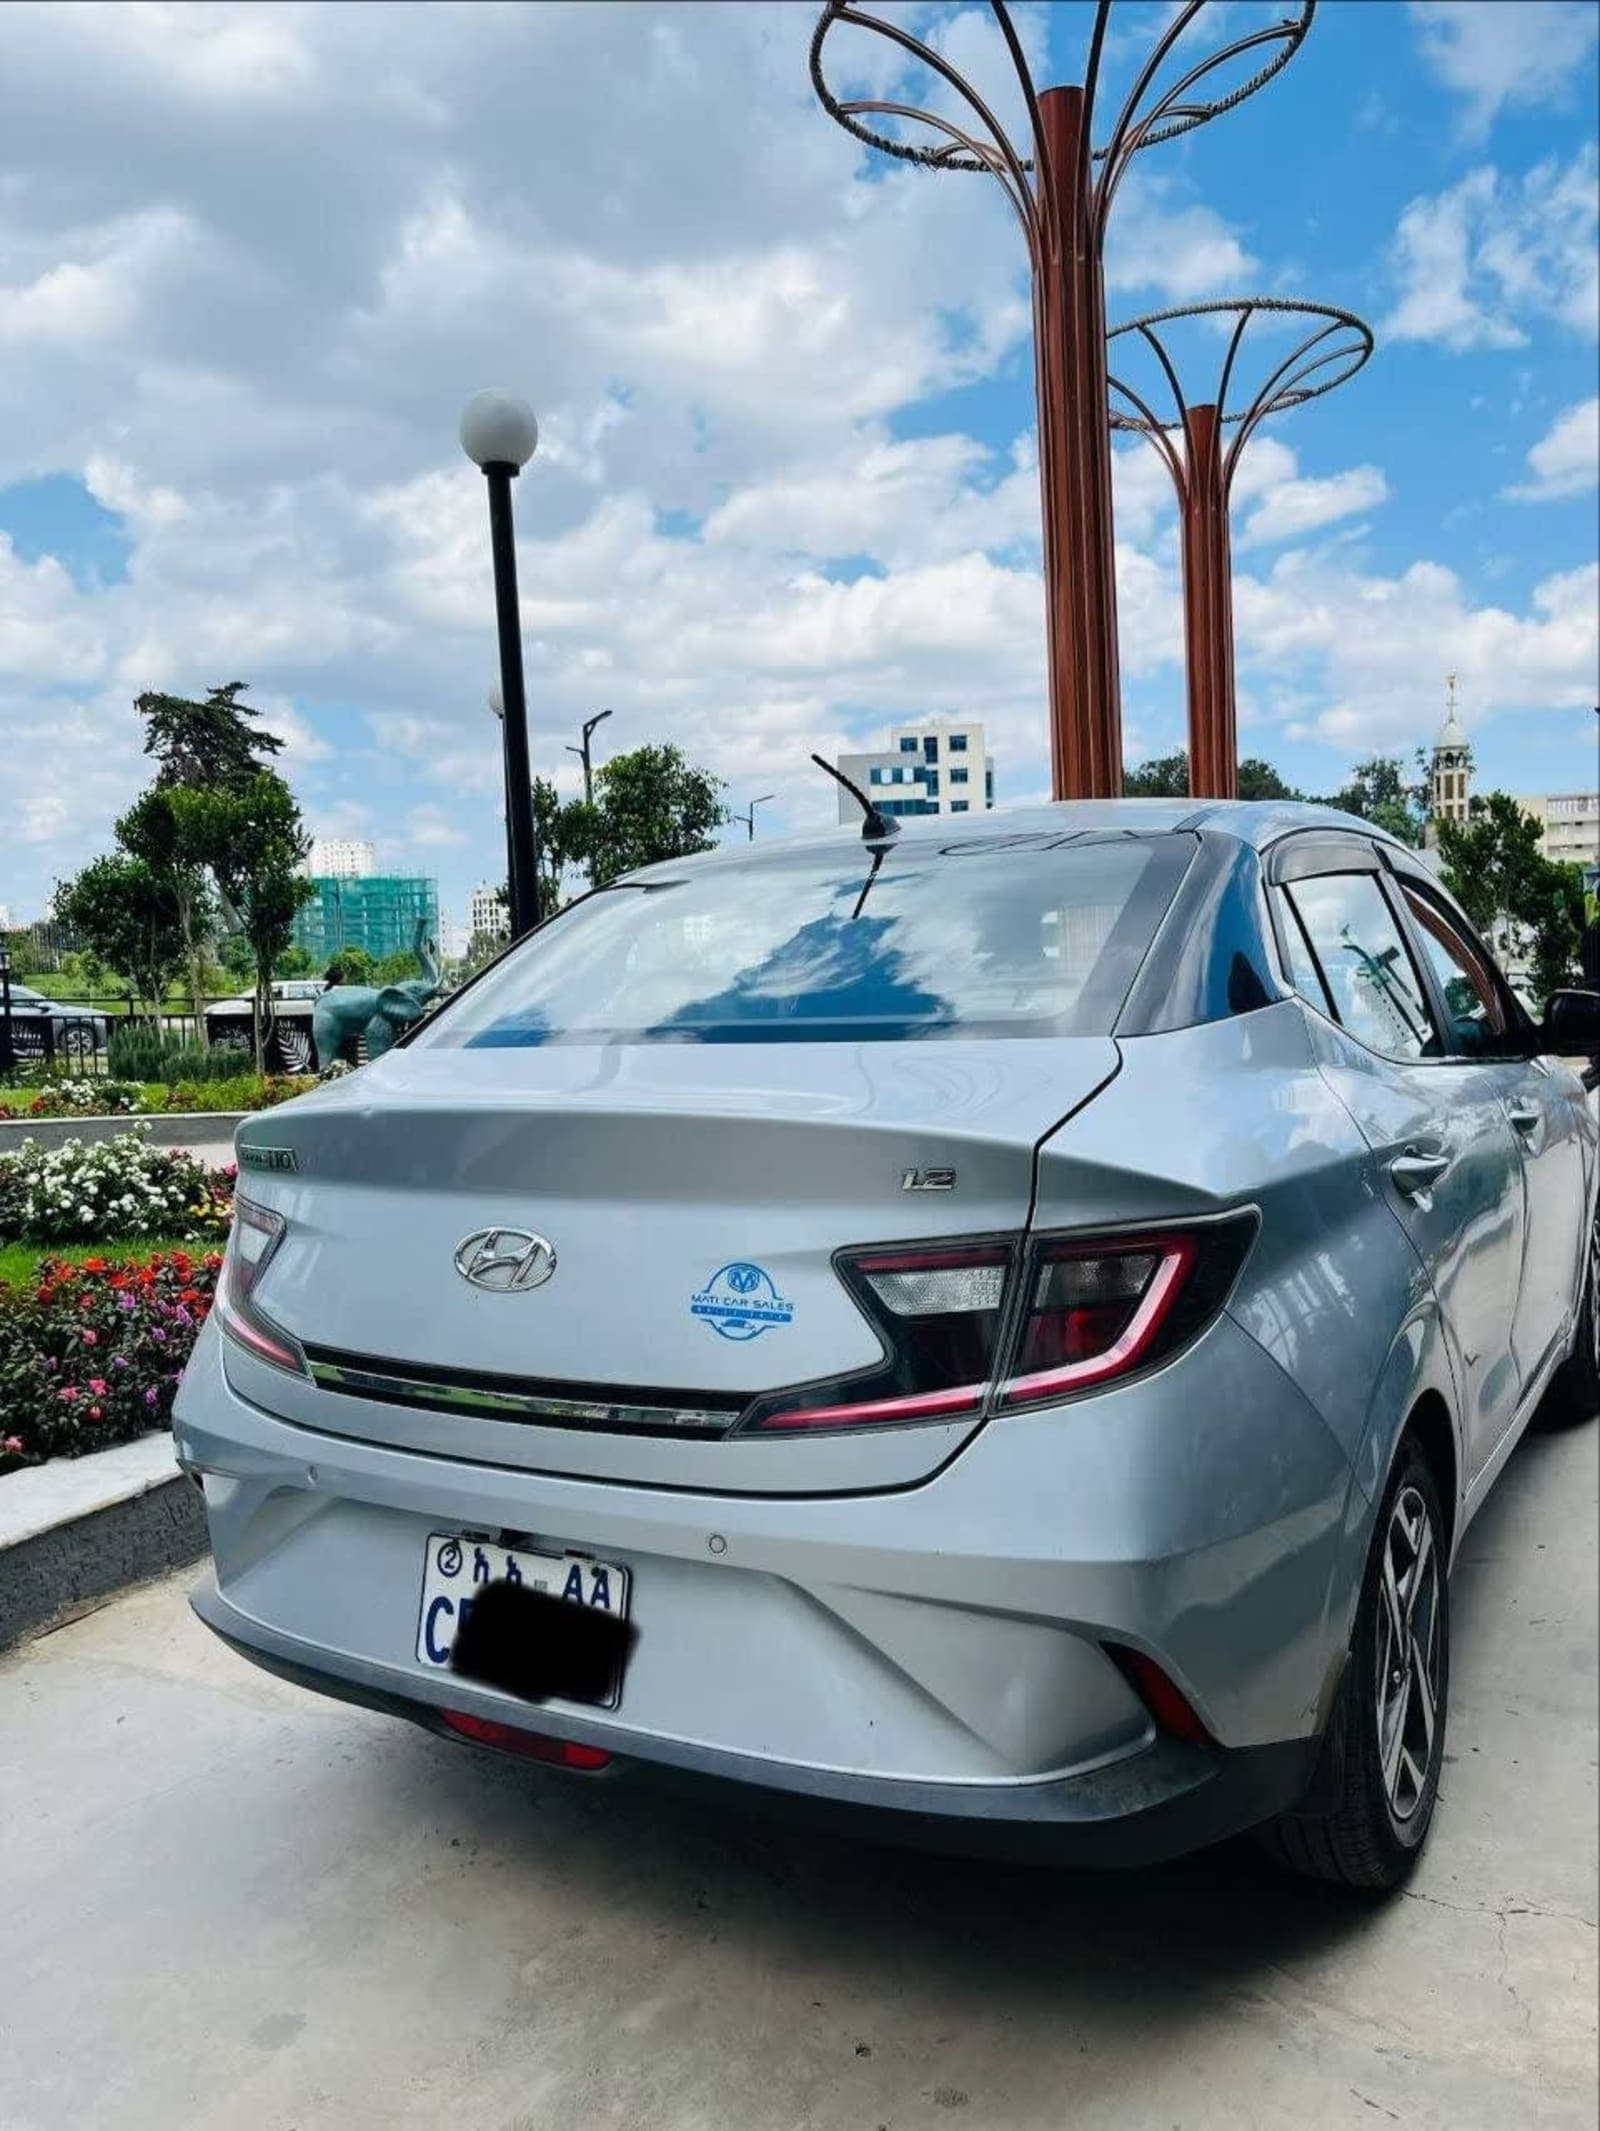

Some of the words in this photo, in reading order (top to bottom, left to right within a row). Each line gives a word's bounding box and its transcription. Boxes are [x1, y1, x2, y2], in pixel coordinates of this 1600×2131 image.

[691, 1294, 719, 1305] MATI
[723, 1297, 748, 1307] CAR
[753, 1300, 793, 1313] SALES
[561, 1564, 611, 1609] AA
